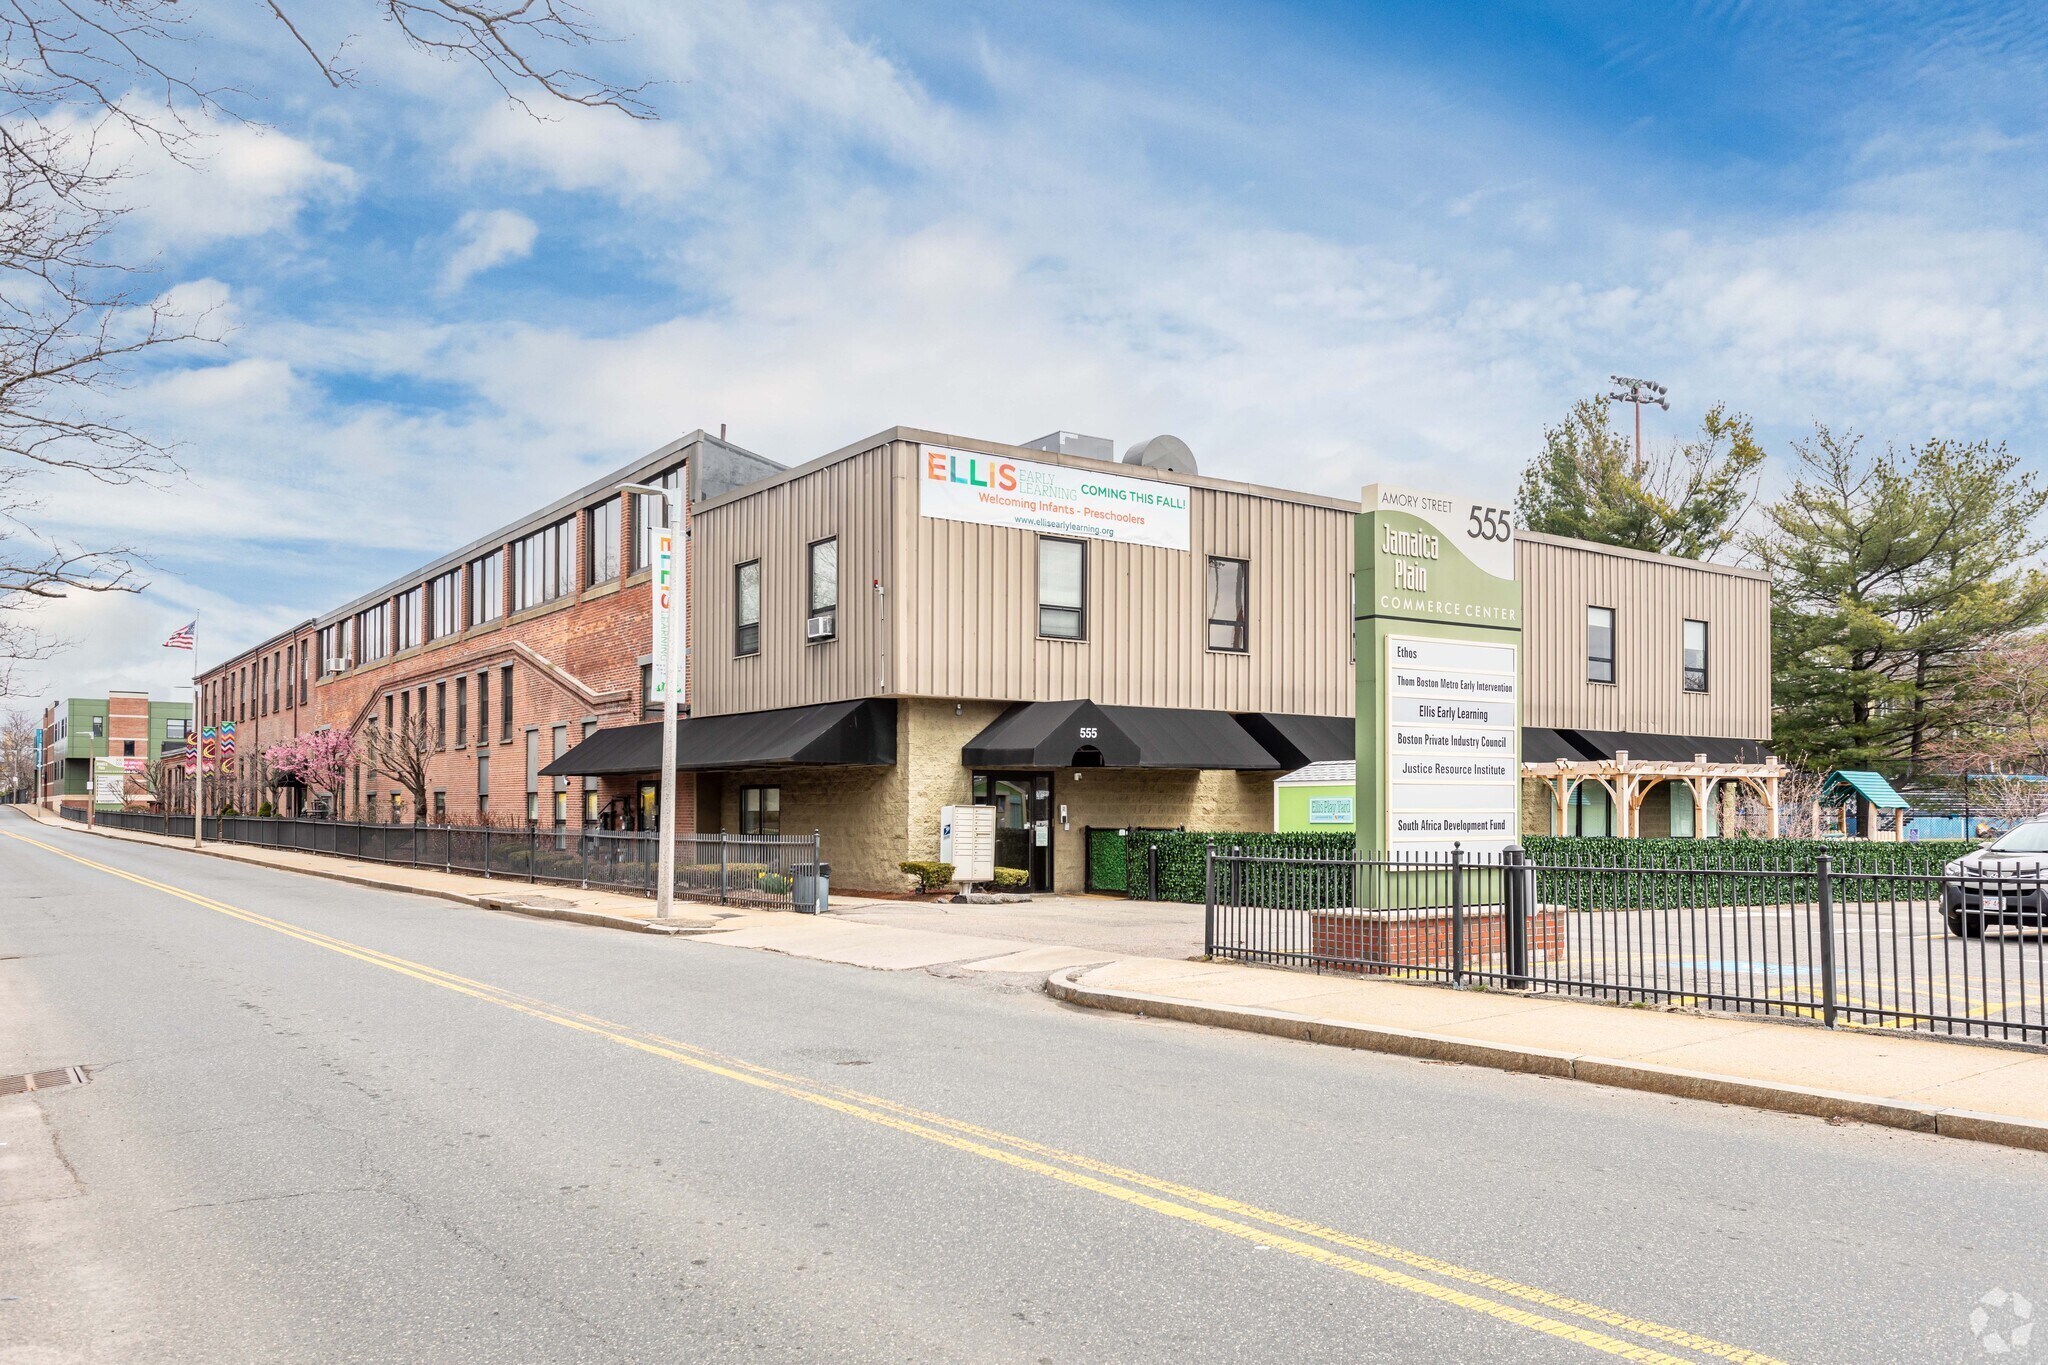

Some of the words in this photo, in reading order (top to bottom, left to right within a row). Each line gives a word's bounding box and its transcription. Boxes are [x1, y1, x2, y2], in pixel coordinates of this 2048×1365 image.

[928, 452, 1017, 491] ELLIS
[1019, 469, 1055, 483] EARLY
[1019, 482, 1077, 501] LEARNING
[1081, 484, 1127, 501] COMING
[1129, 491, 1154, 505] THIS
[1157, 495, 1186, 510] FALL!
[979, 492, 1036, 513] Welcoming
[1039, 501, 1075, 515] Infants
[1084, 507, 1145, 525] Preschoolers
[1381, 492, 1419, 508] AMORY
[1422, 498, 1452, 513] STREET
[1014, 516, 1114, 537] www.ellisearlylearning.org
[1467, 505, 1511, 542] 555
[1381, 523, 1439, 560] Jamaica
[1394, 559, 1427, 592] Plain
[1381, 596, 1460, 615] COMMERCE
[1465, 605, 1515, 621] CENTER
[1397, 646, 1417, 659] Ethos
[1397, 676, 1415, 686] Thom
[1416, 677, 1439, 688] Boston
[1440, 679, 1459, 690] Metro
[1460, 680, 1475, 692] Early
[1476, 681, 1513, 693] Intervention
[1419, 705, 1436, 718] Ellis
[1437, 706, 1456, 721] Early
[1457, 707, 1488, 722] Learning
[1080, 728, 1097, 738] 555
[1397, 733, 1422, 745] Boston
[1424, 734, 1449, 746] Private
[1451, 735, 1480, 749] Industry
[1481, 736, 1506, 748] Council
[1402, 763, 1433, 774] Justice
[1435, 763, 1472, 775] Resource
[1474, 764, 1506, 776] Institute
[1398, 820, 1419, 831] South
[1420, 820, 1442, 831] Africa
[1443, 820, 1488, 833] Development
[1489, 820, 1506, 830] Fund
